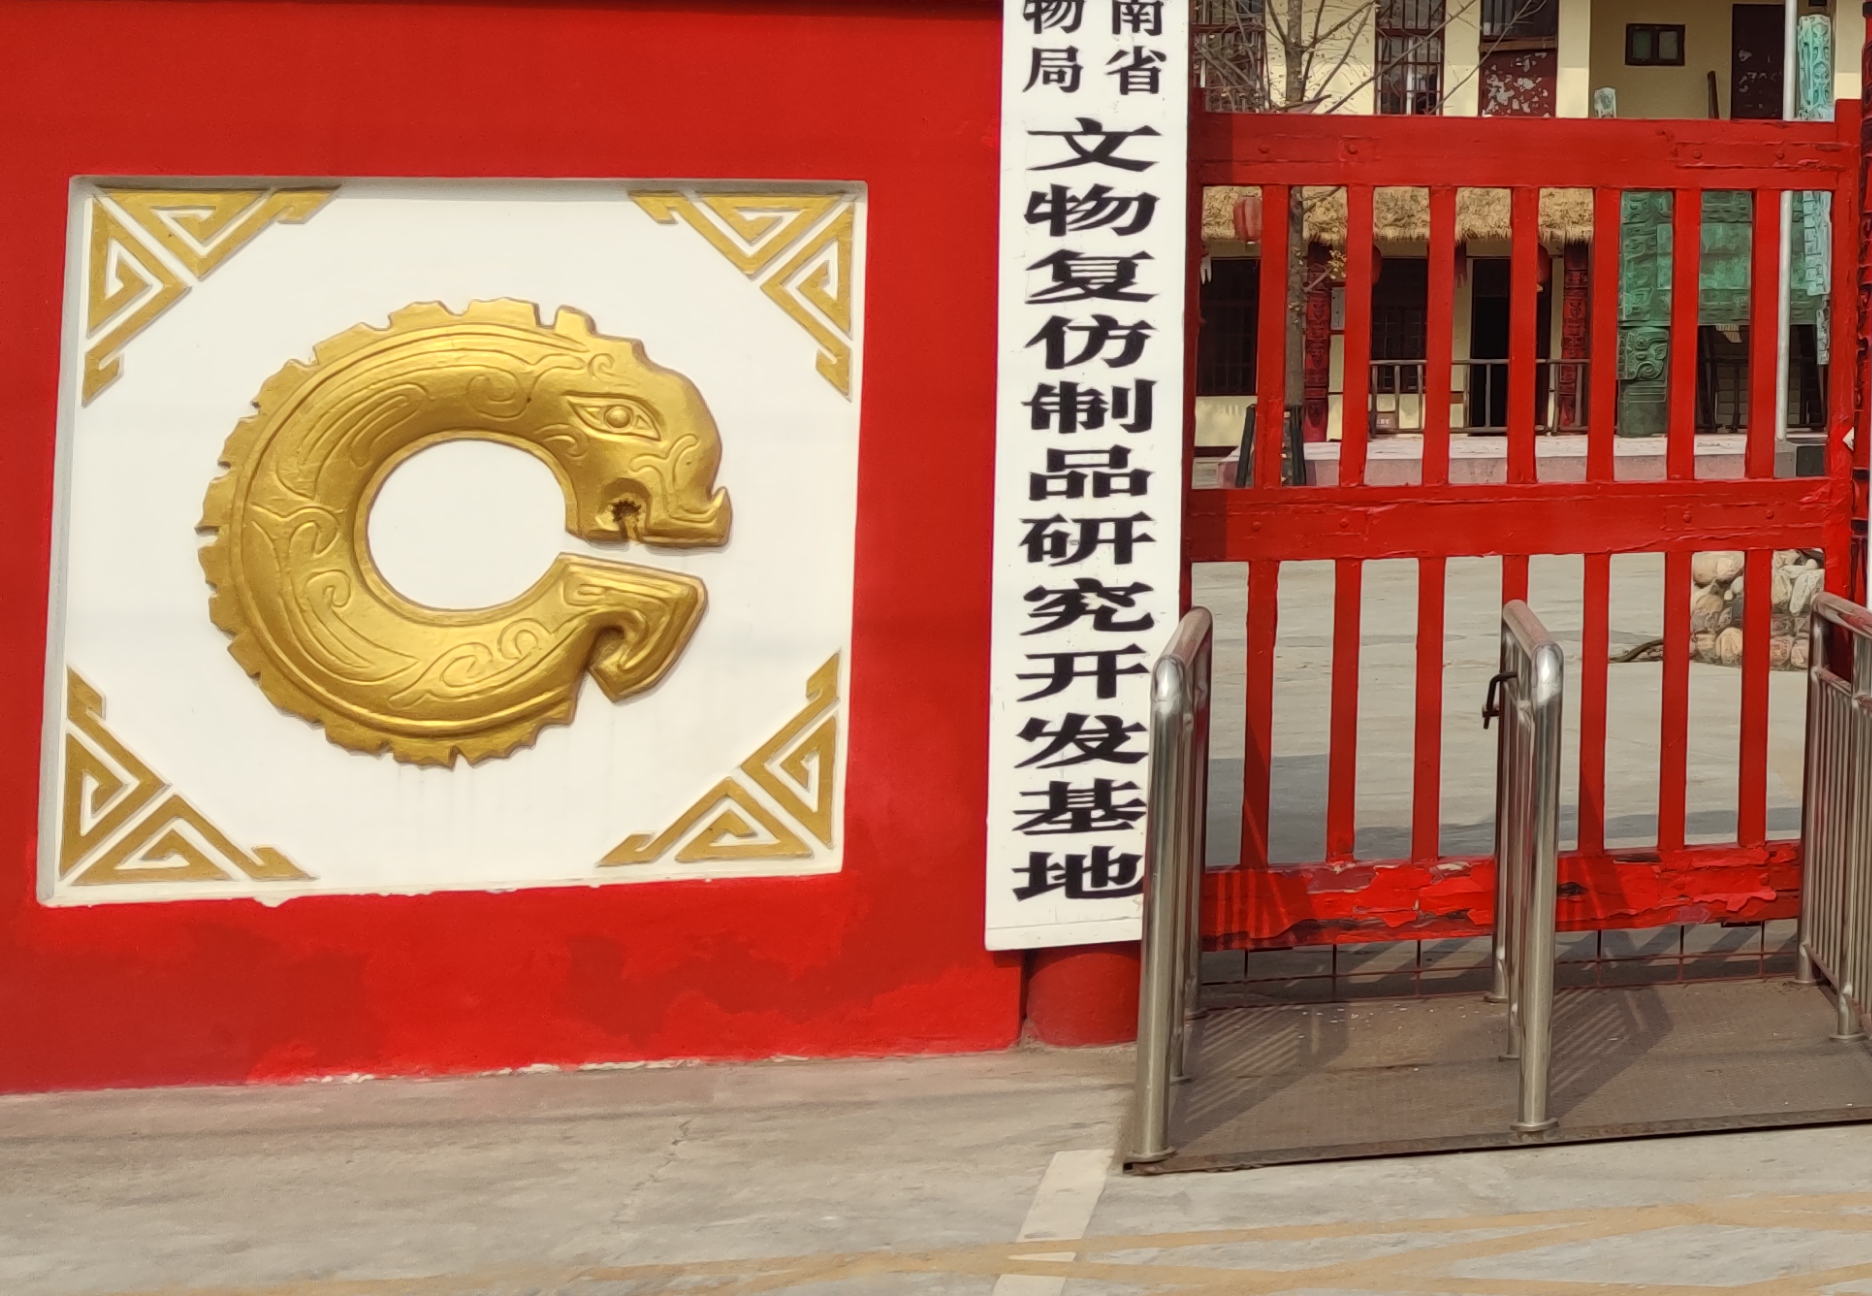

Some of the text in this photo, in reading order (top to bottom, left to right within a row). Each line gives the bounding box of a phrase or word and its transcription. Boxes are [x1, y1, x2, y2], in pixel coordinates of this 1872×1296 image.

[1011, 117, 1164, 901] 文物复仿制品研究开发基地
